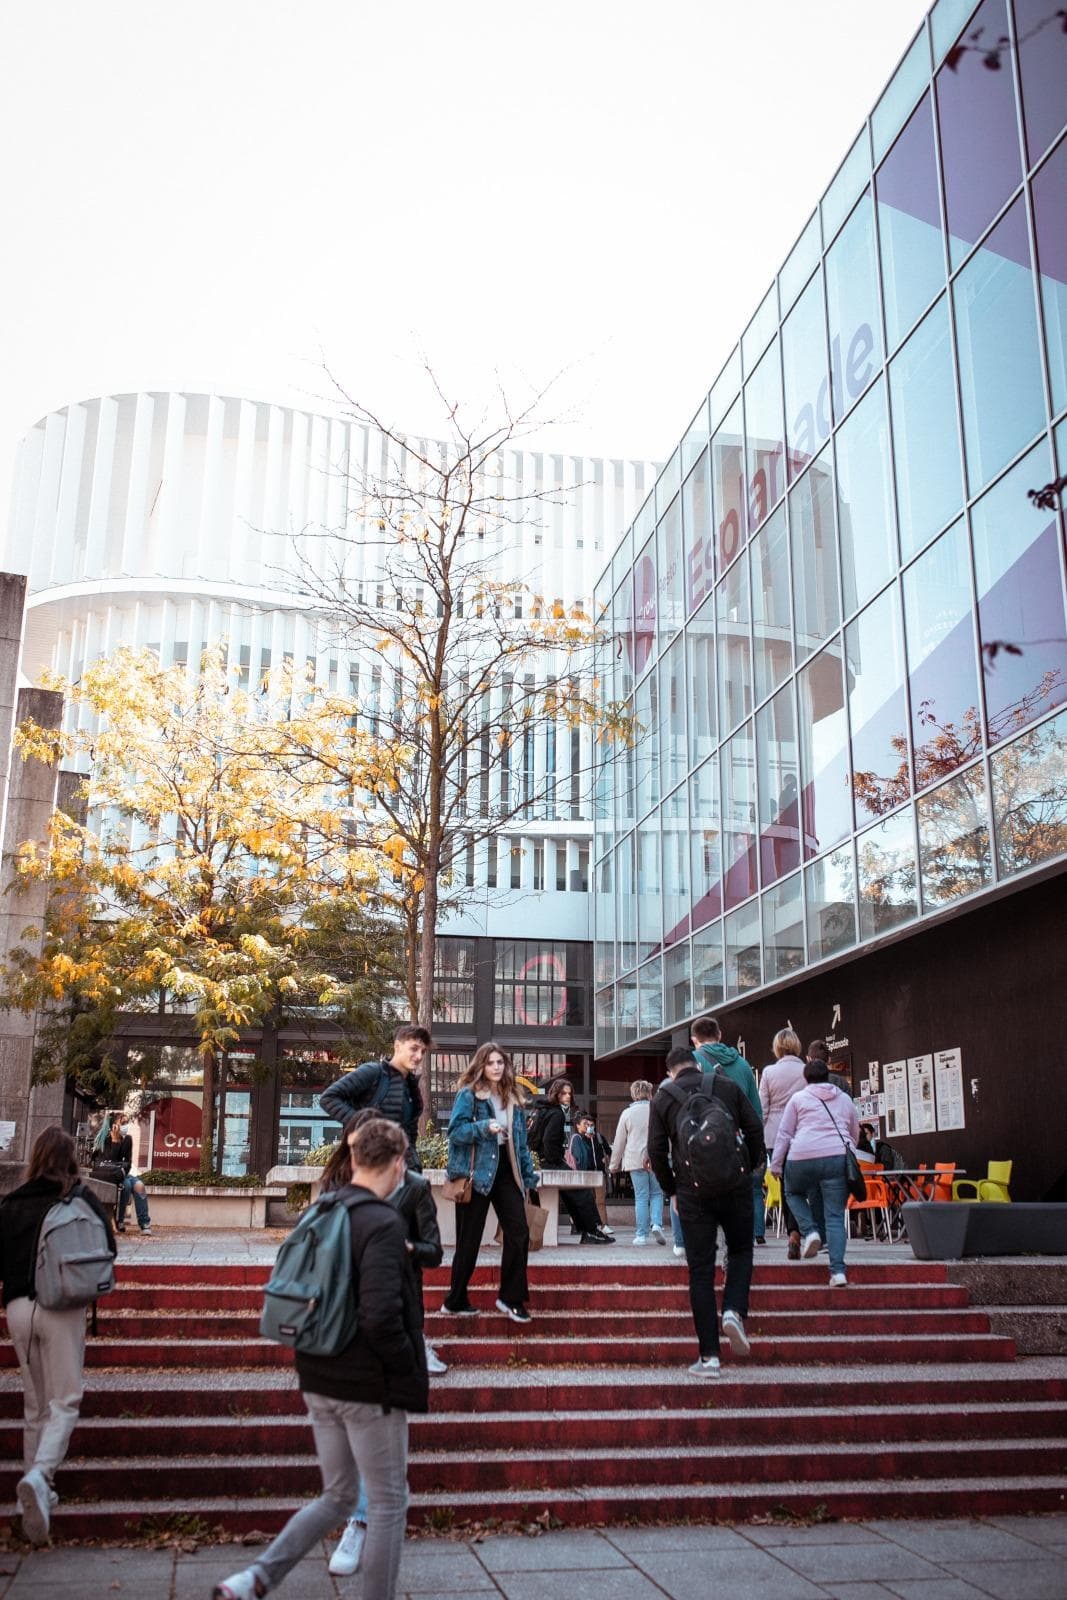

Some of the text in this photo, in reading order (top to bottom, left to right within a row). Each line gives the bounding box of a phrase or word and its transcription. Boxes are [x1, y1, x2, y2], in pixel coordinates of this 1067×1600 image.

[687, 323, 874, 618] Esplanade
[164, 1133, 202, 1148] Crou
[154, 1150, 190, 1159] trasbourg
